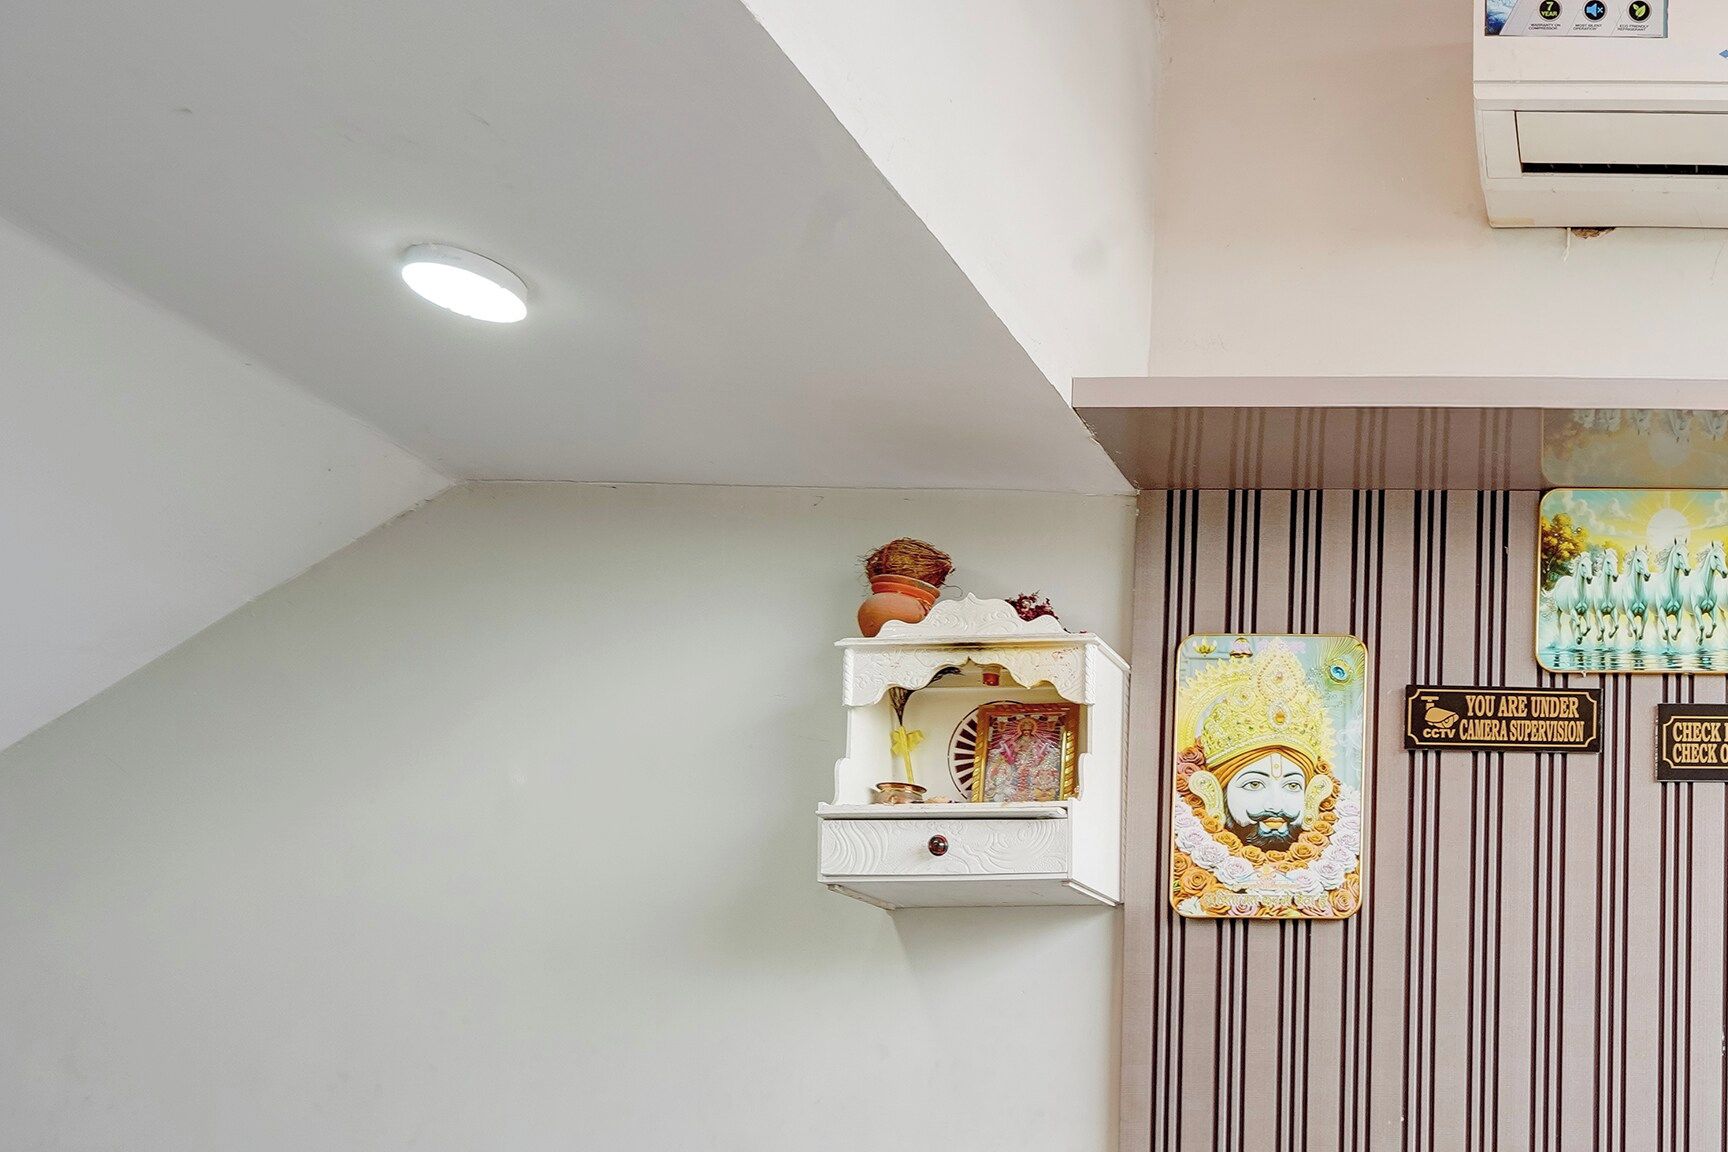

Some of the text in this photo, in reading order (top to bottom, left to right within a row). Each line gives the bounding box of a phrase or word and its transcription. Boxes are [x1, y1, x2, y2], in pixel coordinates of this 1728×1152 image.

[1546, 1, 1554, 11] 7
[1465, 695, 1580, 718] YOU ARE UNDER
[1423, 728, 1456, 739] CCTV
[1459, 719, 1585, 742] CAMERA SUPERVISION
[1672, 722, 1722, 742] CHECK
[1672, 743, 1718, 763] CHECK
